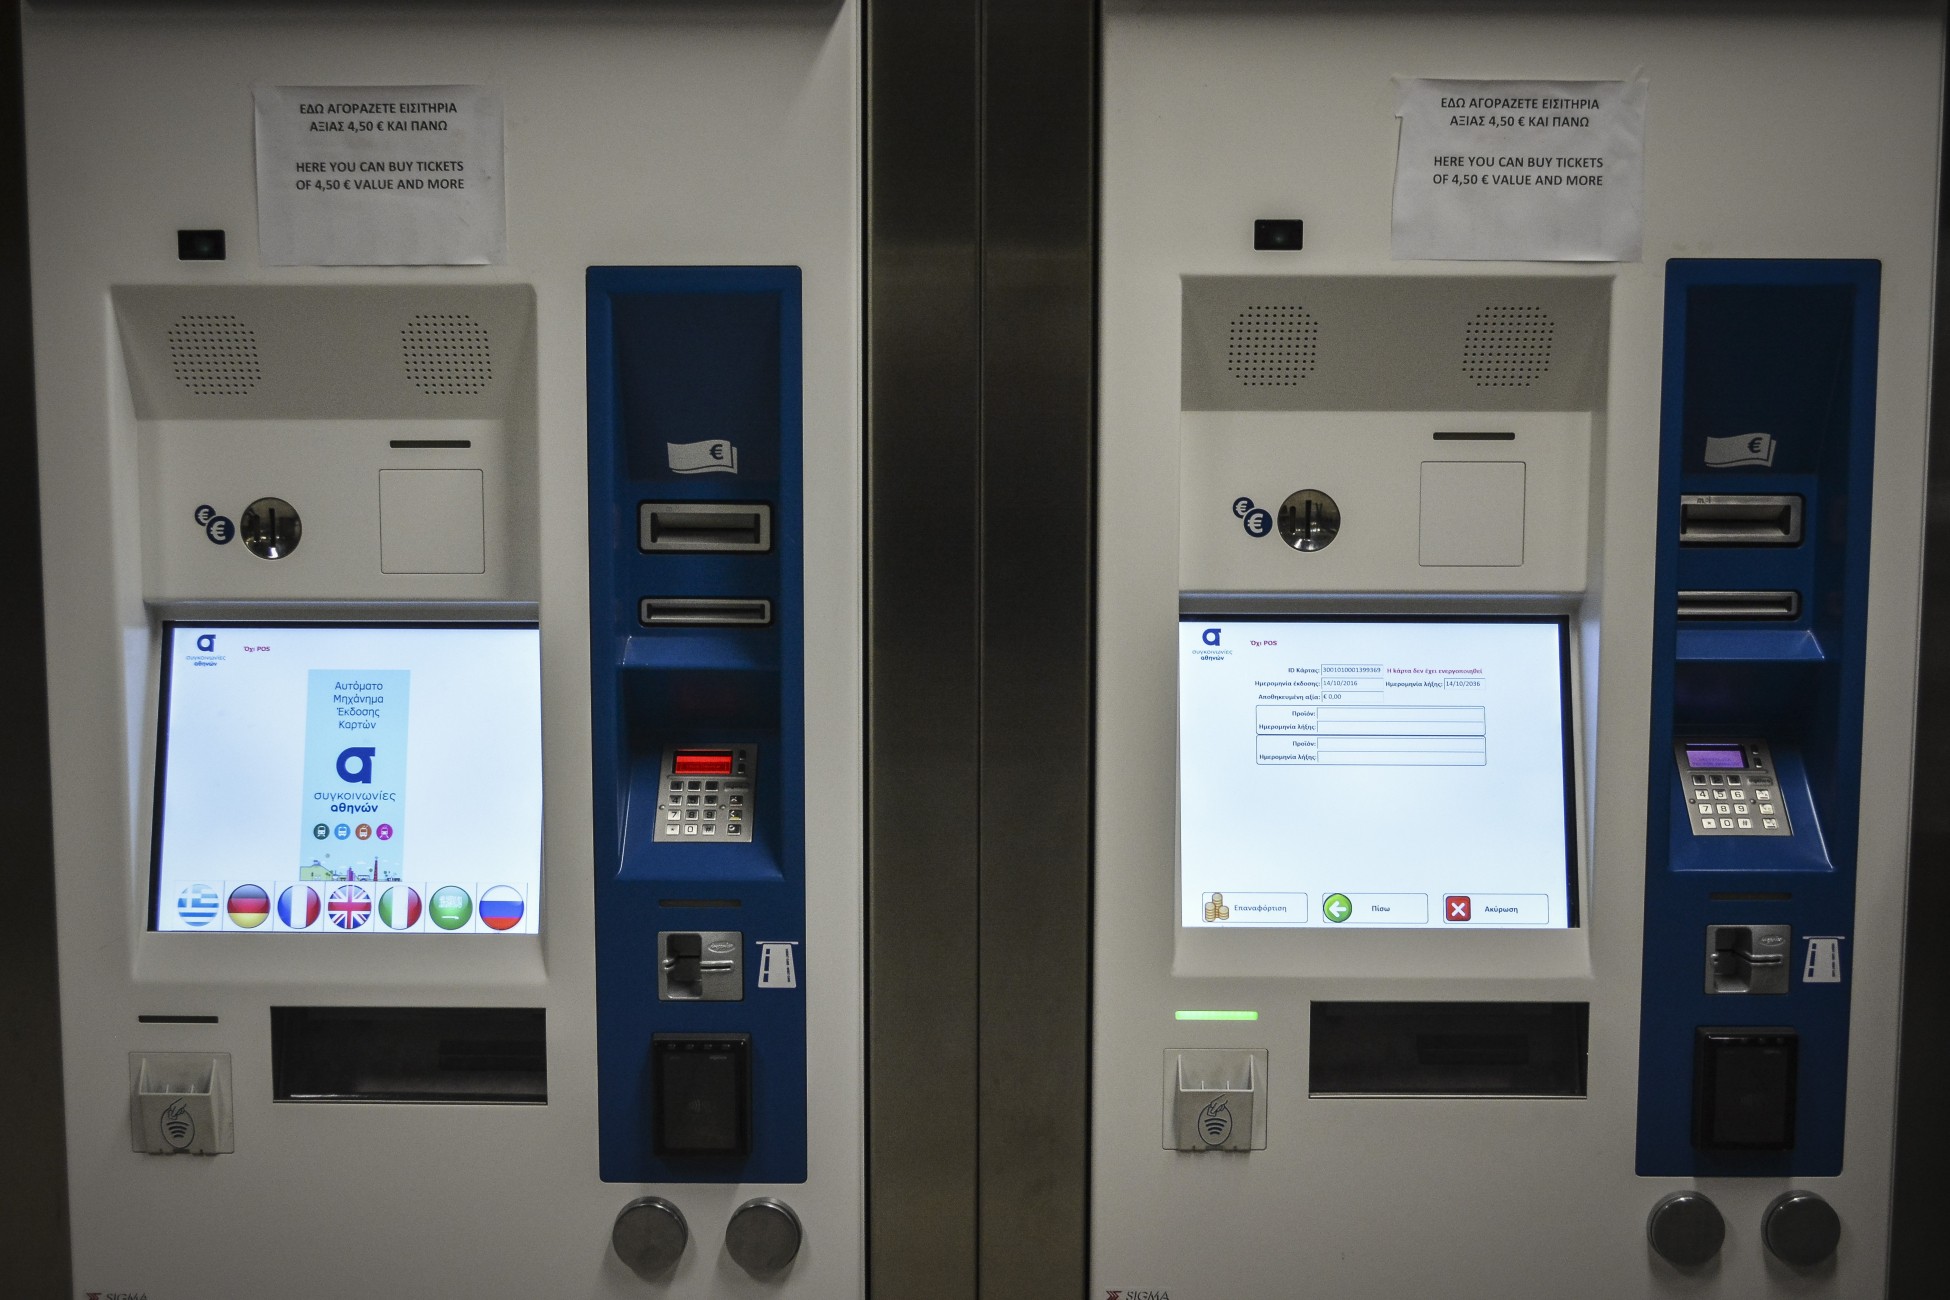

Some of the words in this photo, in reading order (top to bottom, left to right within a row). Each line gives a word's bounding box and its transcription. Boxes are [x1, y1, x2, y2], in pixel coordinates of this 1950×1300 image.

[300, 104, 324, 114] ΕΔΩ
[327, 104, 396, 114] ΑΓΟΡΑΖΕΤΕ
[400, 103, 457, 114] ΕΙΣΙΤΗΡΙΑ
[1441, 98, 1465, 108] ΕΔΩ
[1469, 98, 1538, 109] ΑΓΟΡΑΖΕΤΕ
[1542, 99, 1600, 109] ΕΙΣΙΤΗΡΙΑ
[310, 121, 345, 132] ΑΞΙΑΣ
[347, 121, 373, 133] 4,50
[377, 121, 384, 131] €
[387, 121, 407, 131] ΚΑΙ
[411, 120, 448, 131] ΠΑΝΩ
[1450, 116, 1486, 126] ΑΞΙΑΣ
[1489, 116, 1515, 128] 4,50
[1518, 116, 1525, 127] €
[1529, 116, 1549, 127] ΚΑΙ
[1552, 116, 1590, 127] ΠΑΝΩ
[296, 162, 326, 173] HERE
[330, 162, 356, 172] YOU
[360, 162, 385, 172] CAN
[389, 161, 414, 172] BUY
[417, 161, 464, 172] TICKETS
[1434, 156, 1464, 167] HERE
[1468, 157, 1495, 167] YOU
[1499, 157, 1524, 168] CAN
[1528, 158, 1552, 168] BUY
[1556, 158, 1604, 168] TICKETS
[296, 180, 312, 190] OF
[315, 180, 340, 192] 4,50
[344, 180, 351, 189] €
[355, 179, 393, 190] VALUE
[398, 179, 424, 189] AND
[428, 179, 465, 190] MORE
[1433, 174, 1449, 185] OF
[1452, 175, 1478, 187] 4,50
[1481, 175, 1489, 185] €
[1492, 175, 1532, 186] VALUE
[1535, 175, 1563, 186] AND
[1566, 176, 1603, 186] MORE
[334, 681, 384, 692] Αυτόματο
[333, 694, 384, 705] Μηχάνημα
[337, 707, 380, 718] Έκδοσης
[338, 720, 376, 730] Καρτών
[314, 791, 396, 801] συγκοινωνίες
[1700, 790, 1706, 798] 4
[330, 803, 378, 814] αθηνών
[1126, 1291, 1169, 1300] SIGMA
